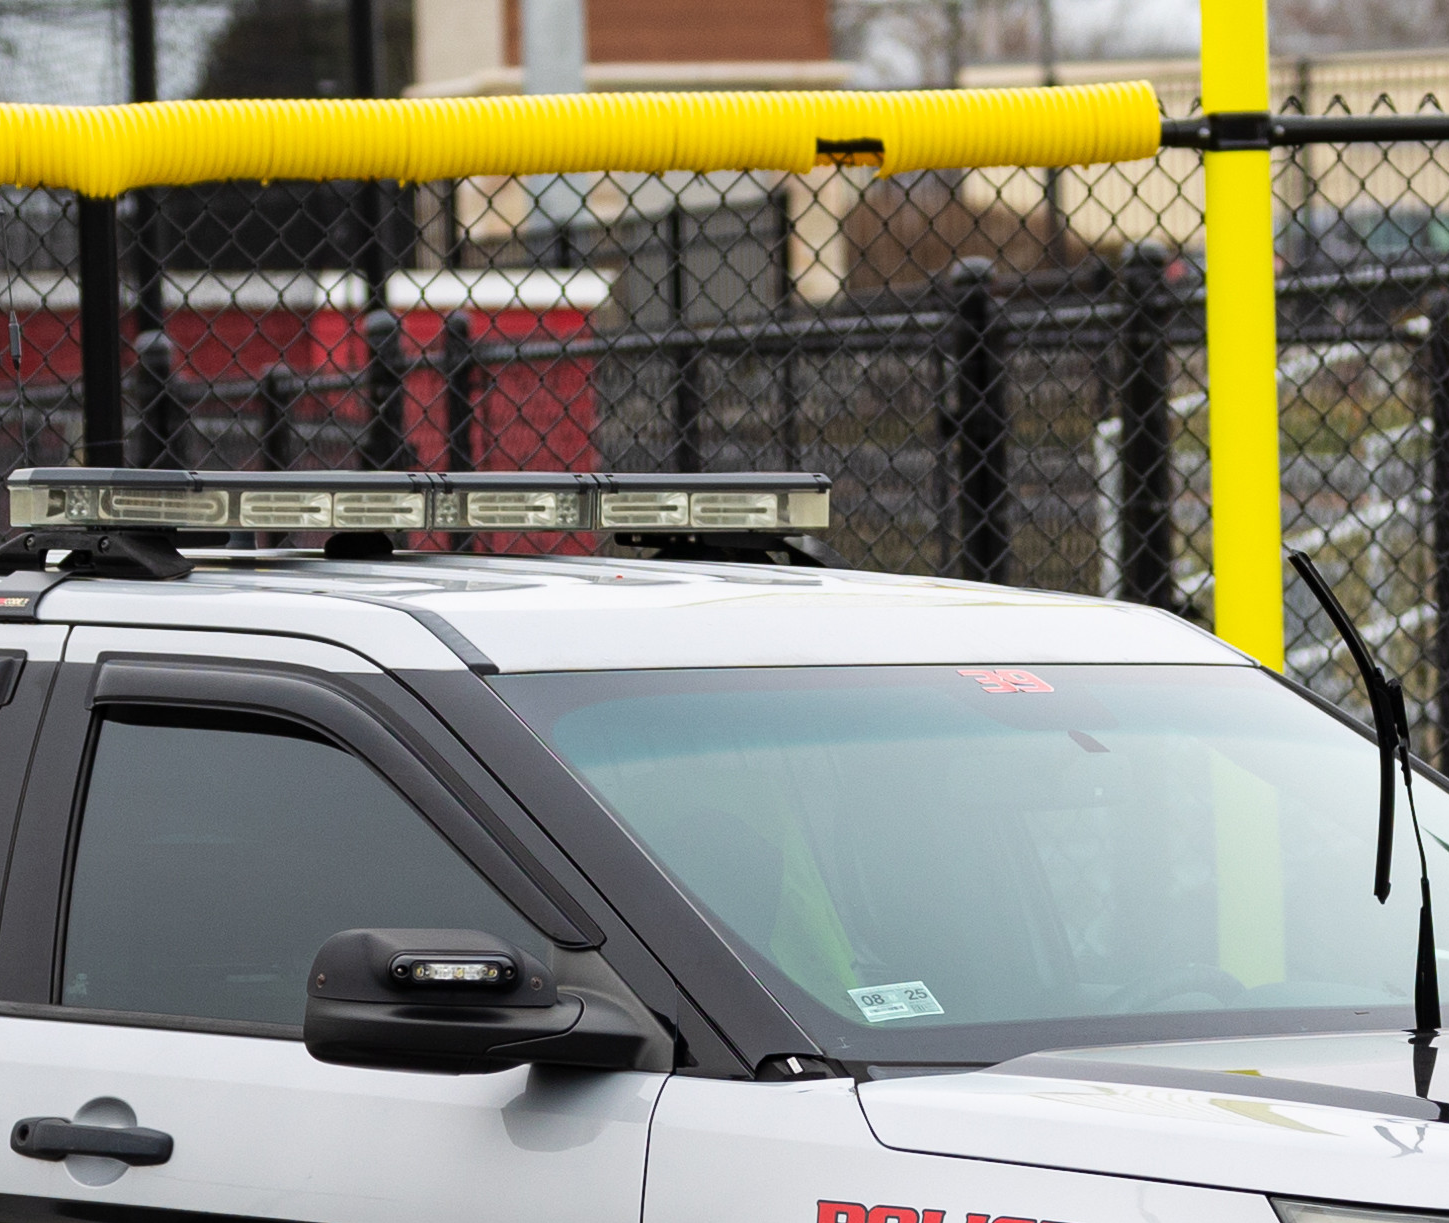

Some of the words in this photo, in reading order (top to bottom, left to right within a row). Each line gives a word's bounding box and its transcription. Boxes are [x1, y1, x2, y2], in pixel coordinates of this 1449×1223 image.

[955, 668, 1056, 694] 39
[861, 993, 885, 1006] 08
[904, 988, 928, 1000] 25
